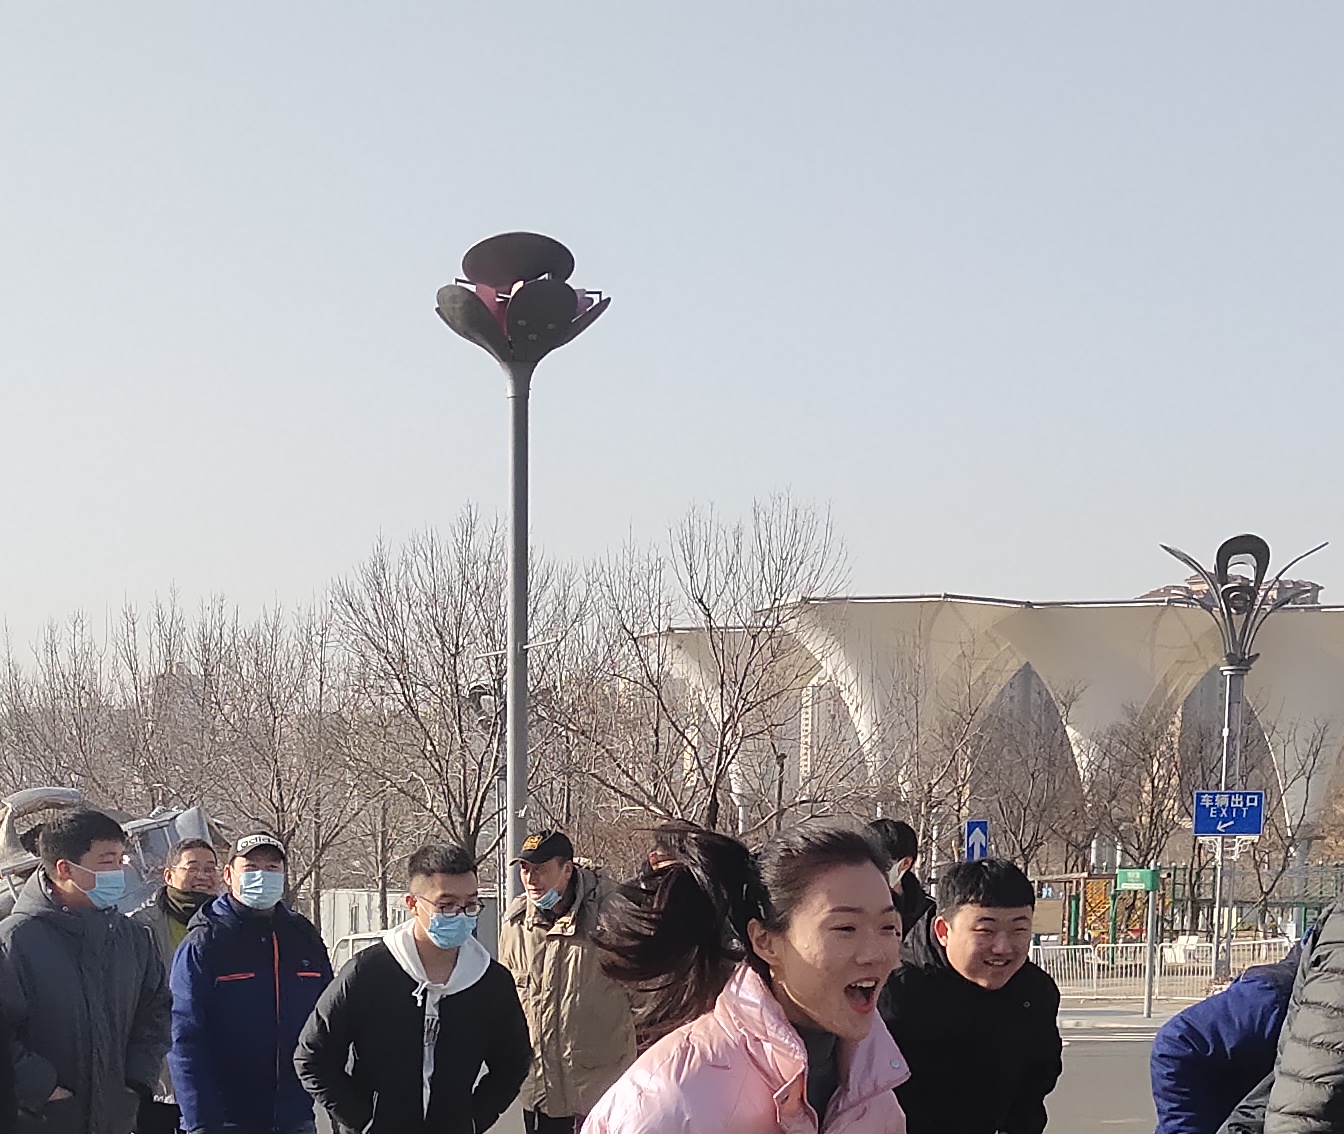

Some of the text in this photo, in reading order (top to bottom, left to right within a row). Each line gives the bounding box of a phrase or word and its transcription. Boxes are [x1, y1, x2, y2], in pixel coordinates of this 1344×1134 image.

[1199, 794, 1258, 808] 车辆出口
[1209, 807, 1249, 818] EXIT
